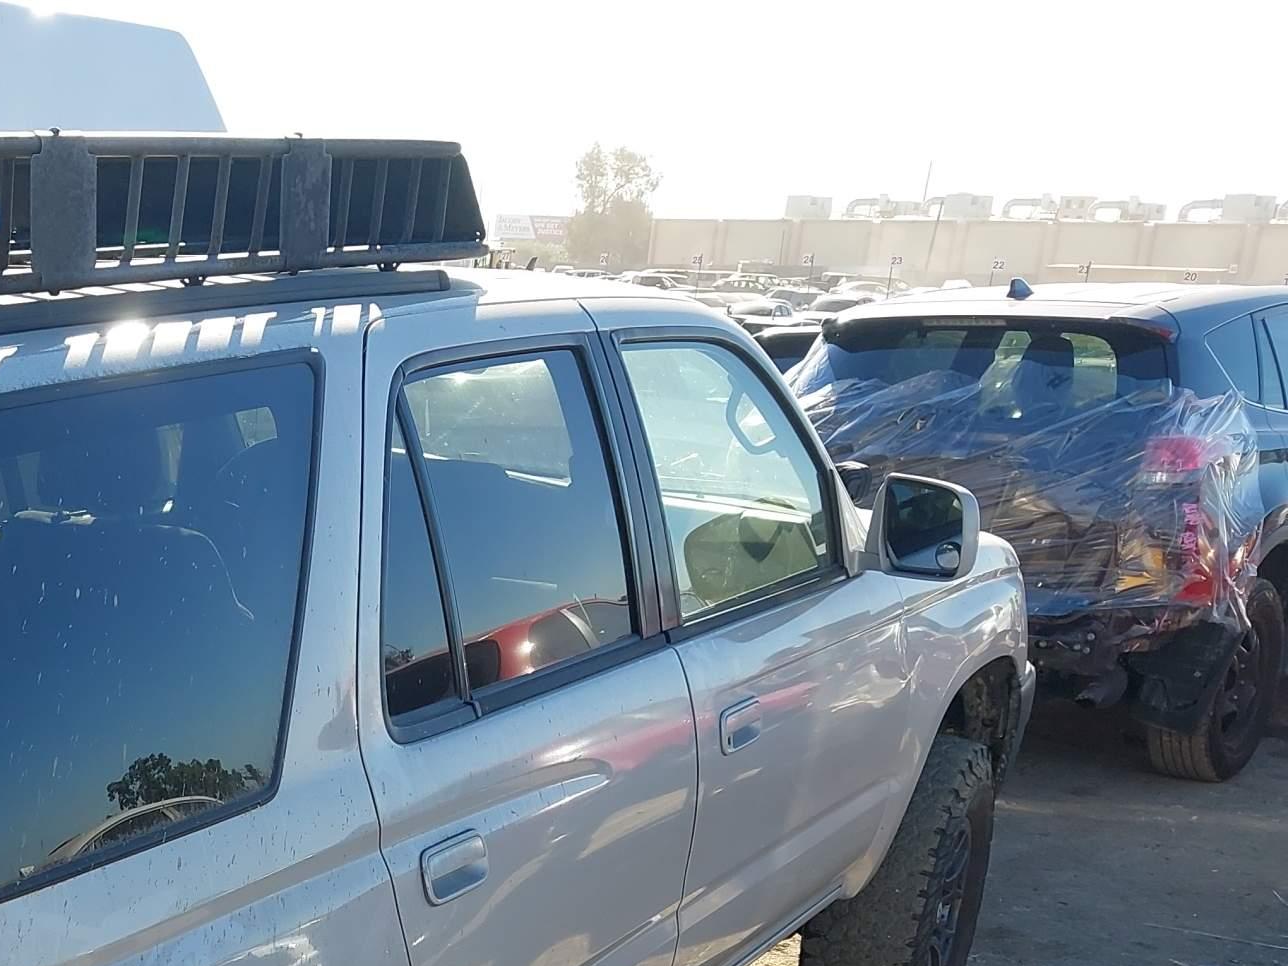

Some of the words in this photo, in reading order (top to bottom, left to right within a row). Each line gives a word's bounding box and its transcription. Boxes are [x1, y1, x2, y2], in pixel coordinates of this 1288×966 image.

[891, 256, 903, 265] 23
[992, 260, 1005, 269] 22
[1183, 271, 1198, 281] 20
